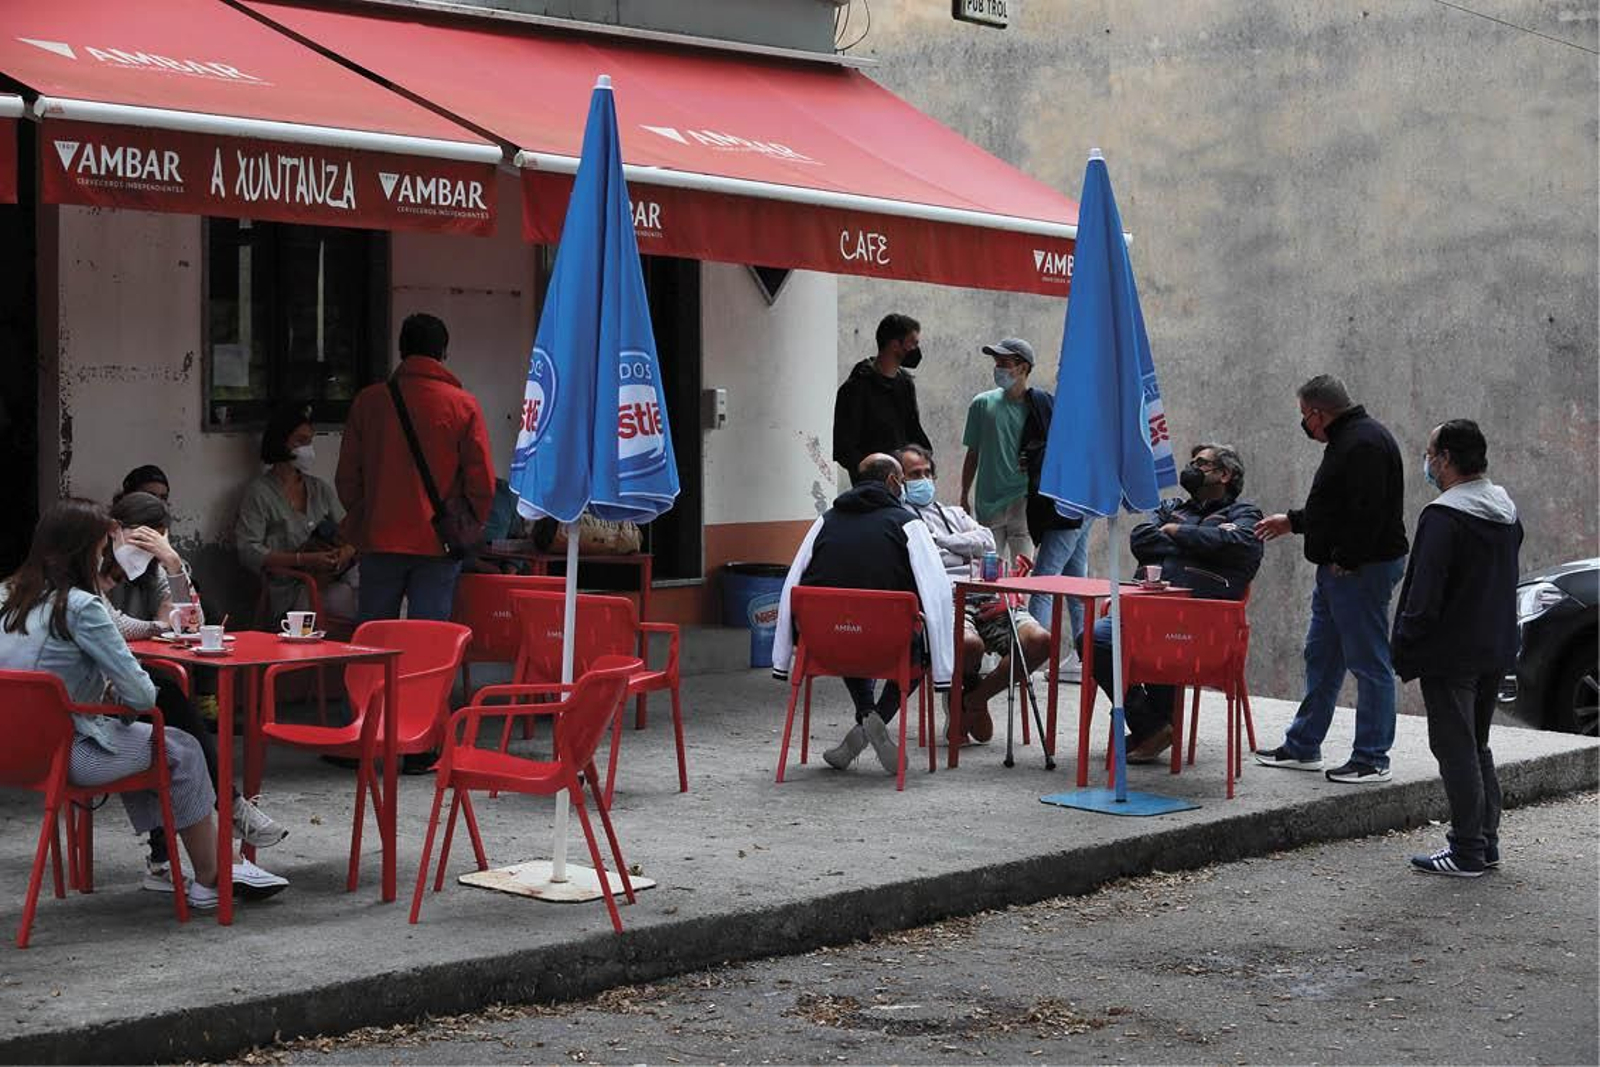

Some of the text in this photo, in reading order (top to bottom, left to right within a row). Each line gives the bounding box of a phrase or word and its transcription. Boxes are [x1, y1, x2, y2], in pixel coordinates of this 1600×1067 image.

[85, 46, 263, 81] AMBAR
[77, 143, 183, 182] AMBAR
[211, 147, 356, 210] A XUNTANZA
[398, 175, 487, 210] AMBAR
[840, 230, 890, 264] CAFE
